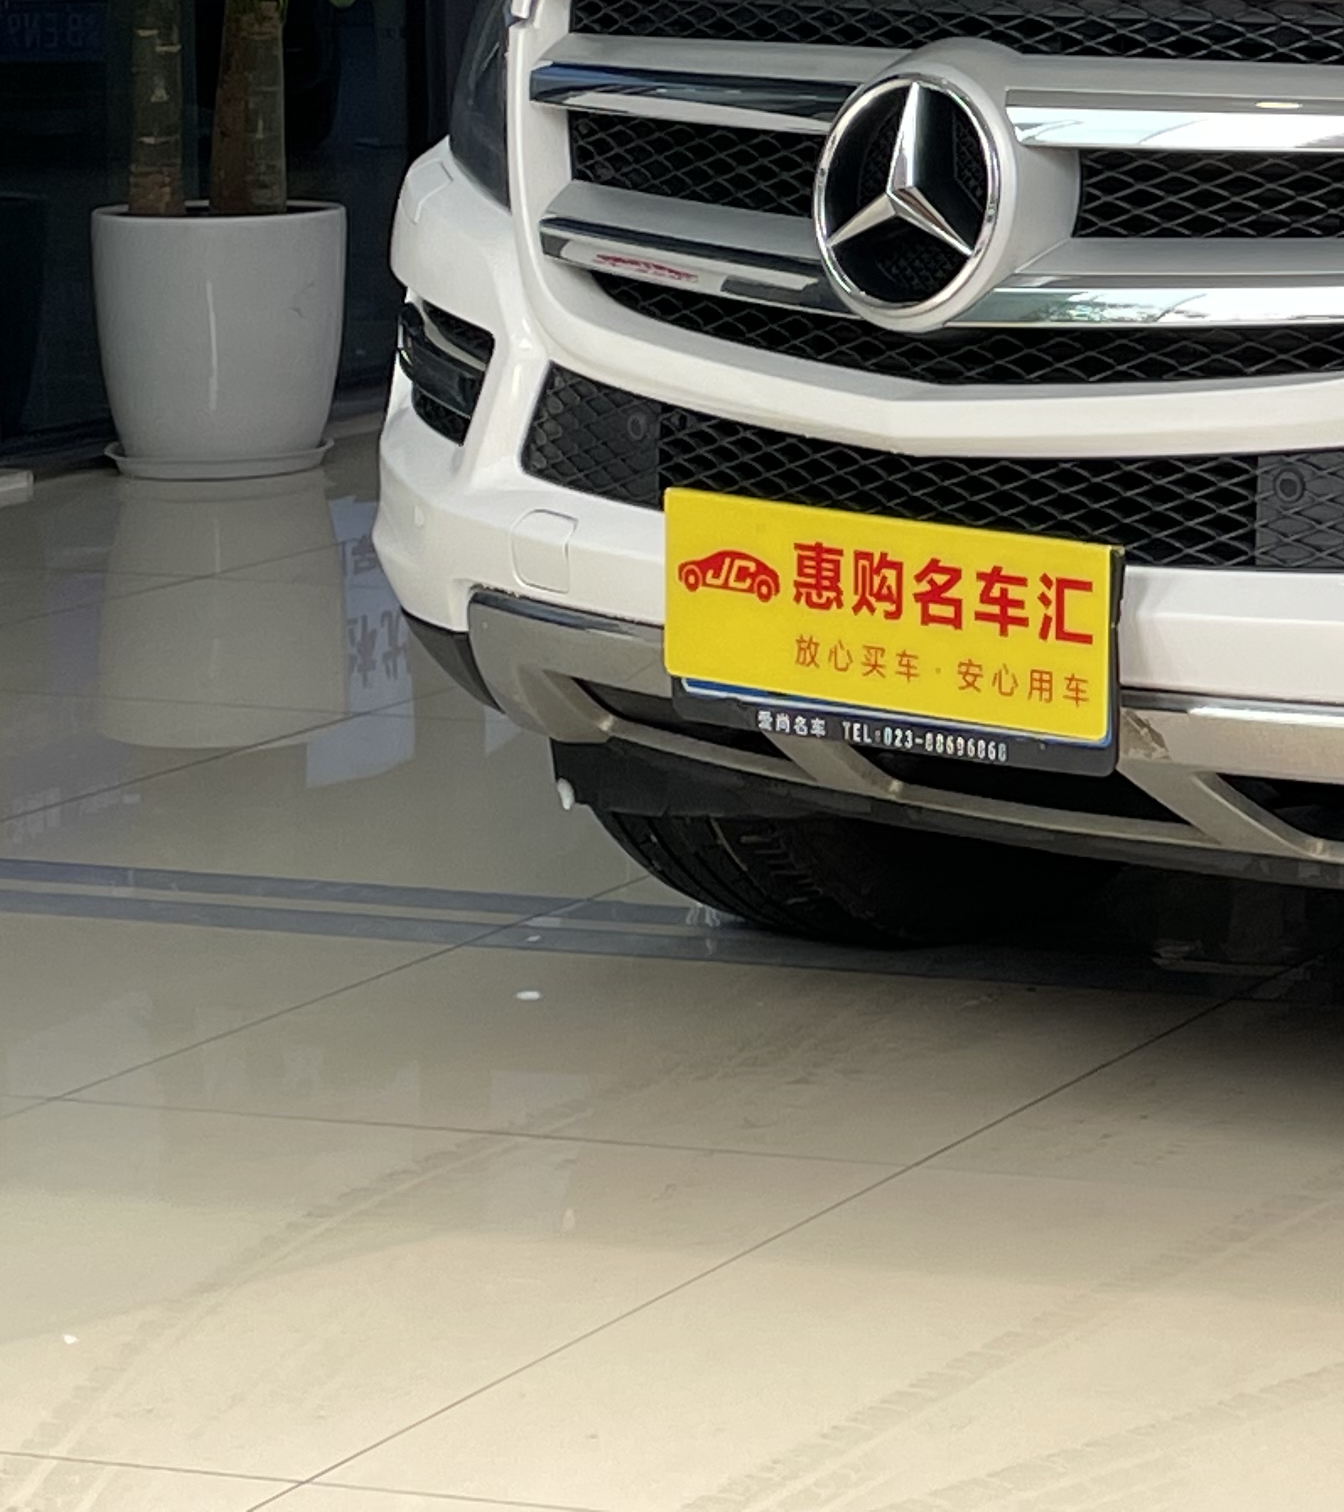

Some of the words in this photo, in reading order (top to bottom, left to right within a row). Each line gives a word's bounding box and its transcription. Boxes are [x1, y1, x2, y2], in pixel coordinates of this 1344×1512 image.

[793, 541, 1094, 645] 惠购名车汇
